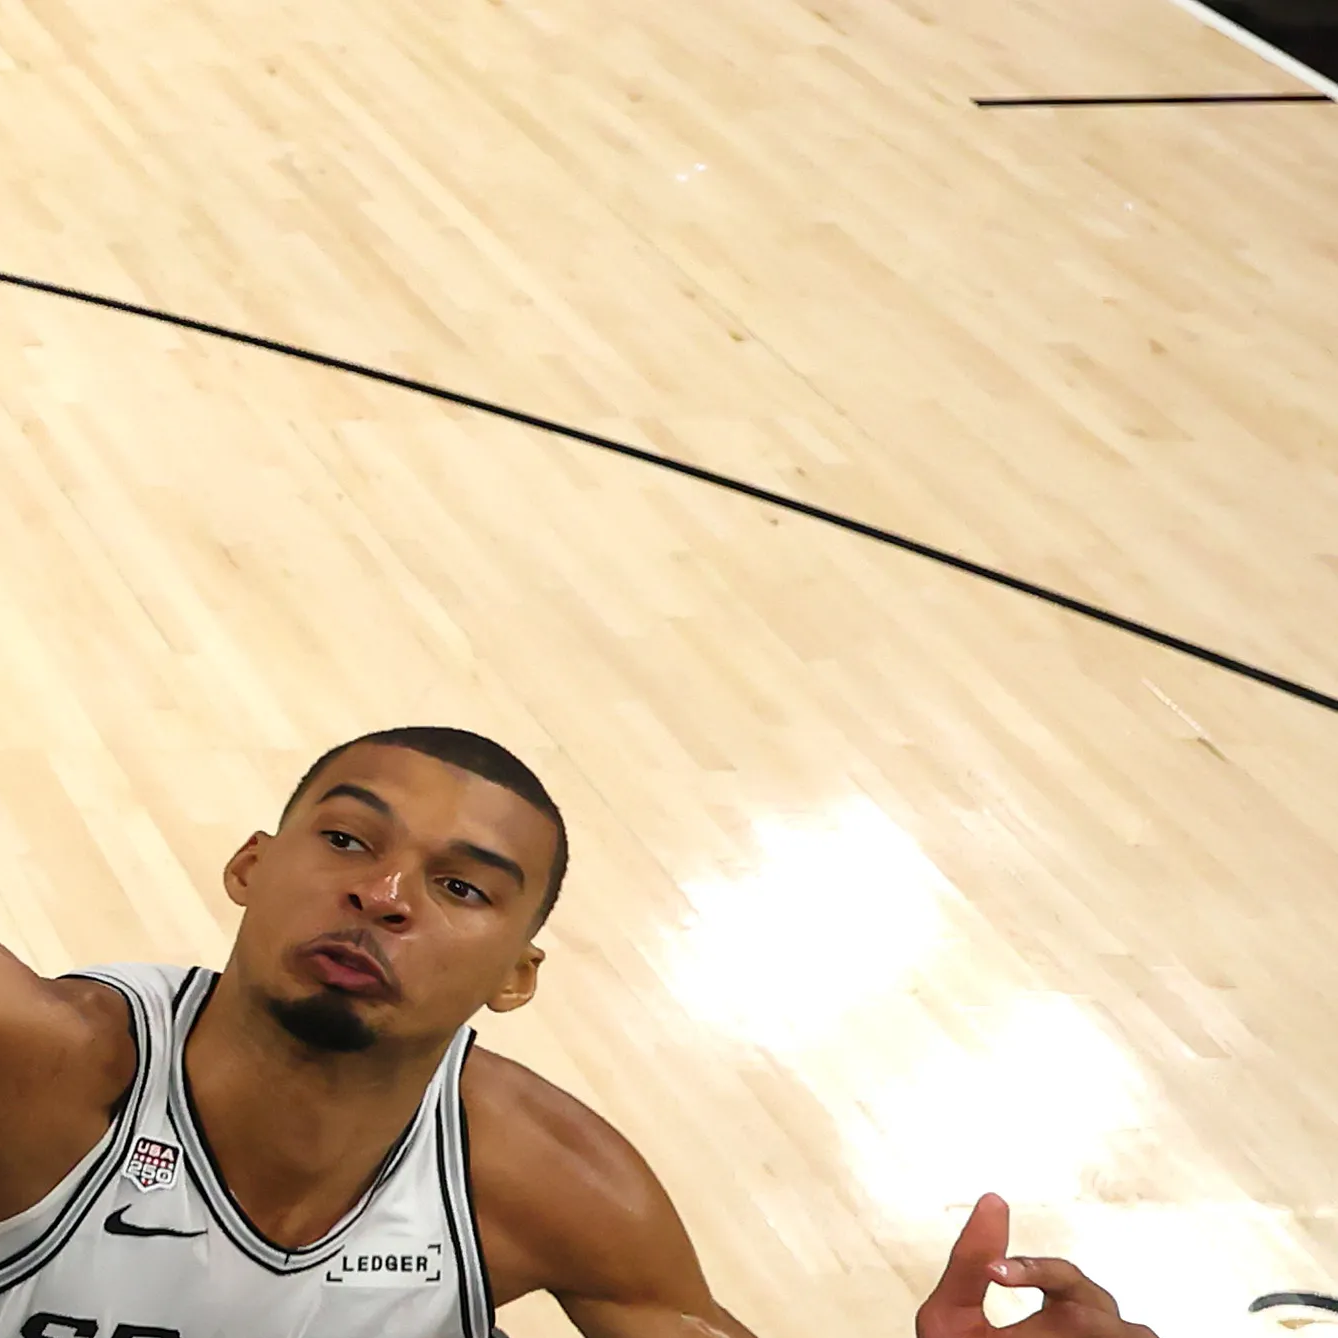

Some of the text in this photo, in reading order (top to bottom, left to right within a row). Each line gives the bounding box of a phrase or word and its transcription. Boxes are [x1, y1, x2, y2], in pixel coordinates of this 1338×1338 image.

[137, 1140, 175, 1162] USA
[127, 1160, 173, 1183] 250
[342, 1254, 428, 1273] LEDGER
